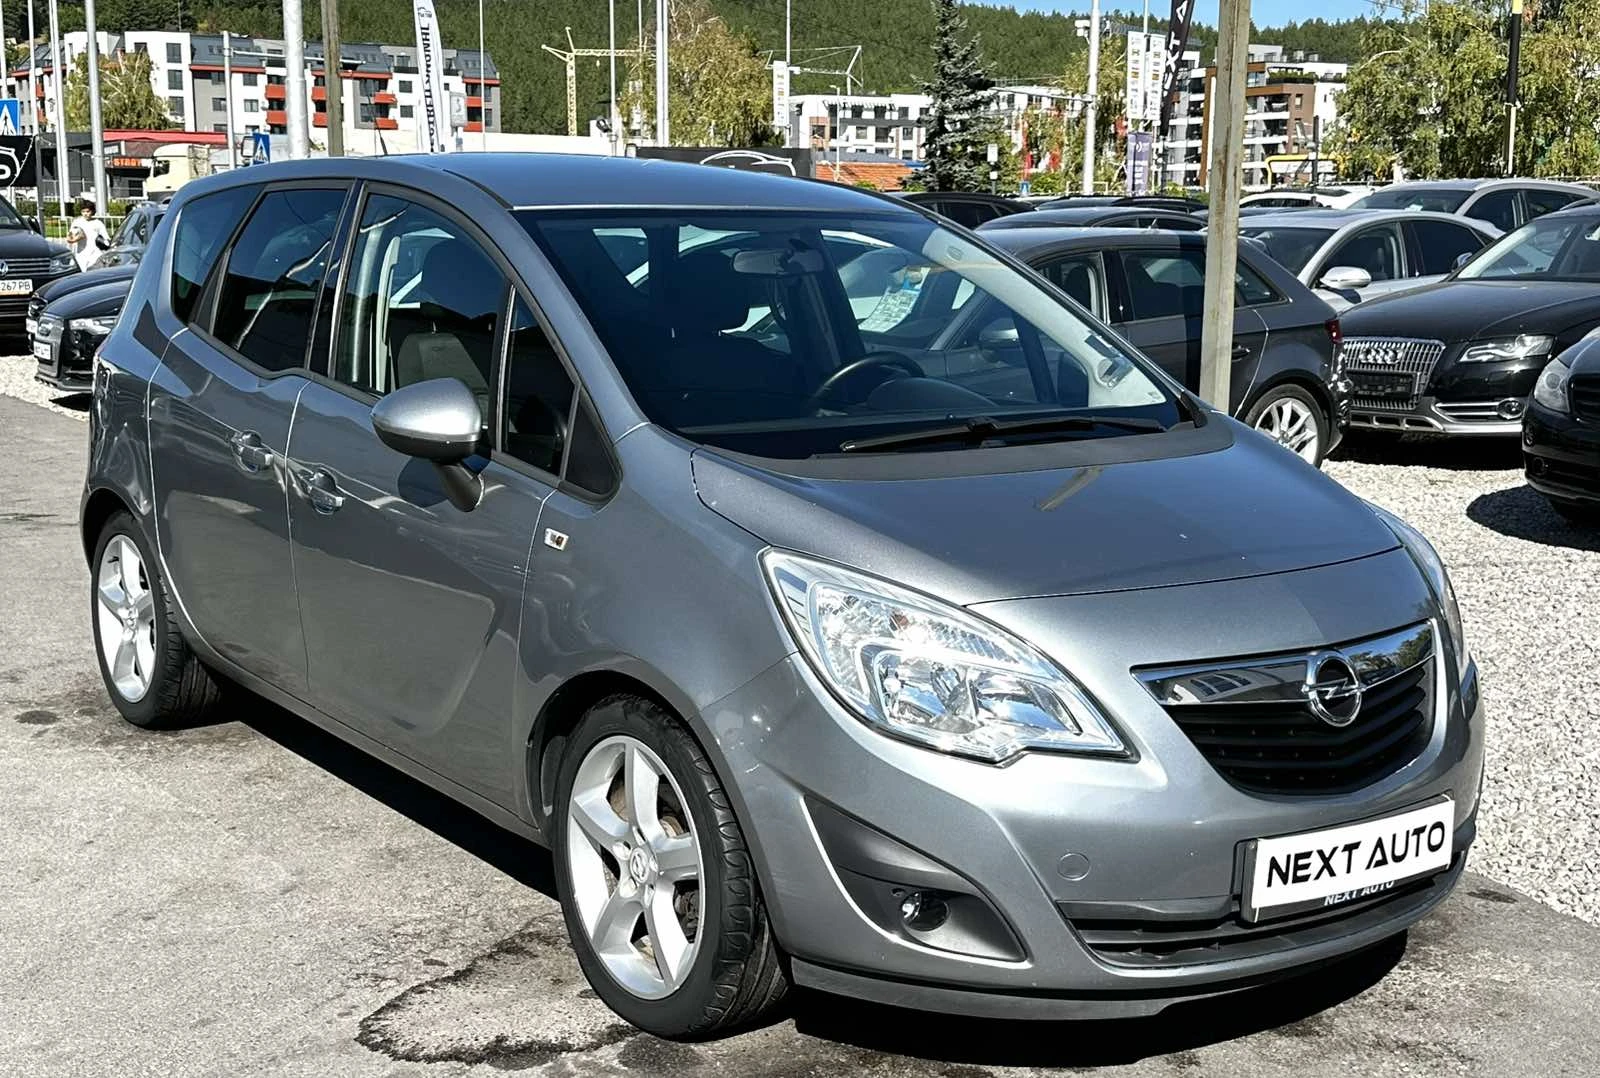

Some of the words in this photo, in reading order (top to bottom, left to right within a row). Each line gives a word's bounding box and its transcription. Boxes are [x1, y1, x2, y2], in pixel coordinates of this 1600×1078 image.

[1266, 840, 1362, 888] NEXT
[1365, 821, 1445, 870] AUTO
[1323, 889, 1360, 906] NEXT
